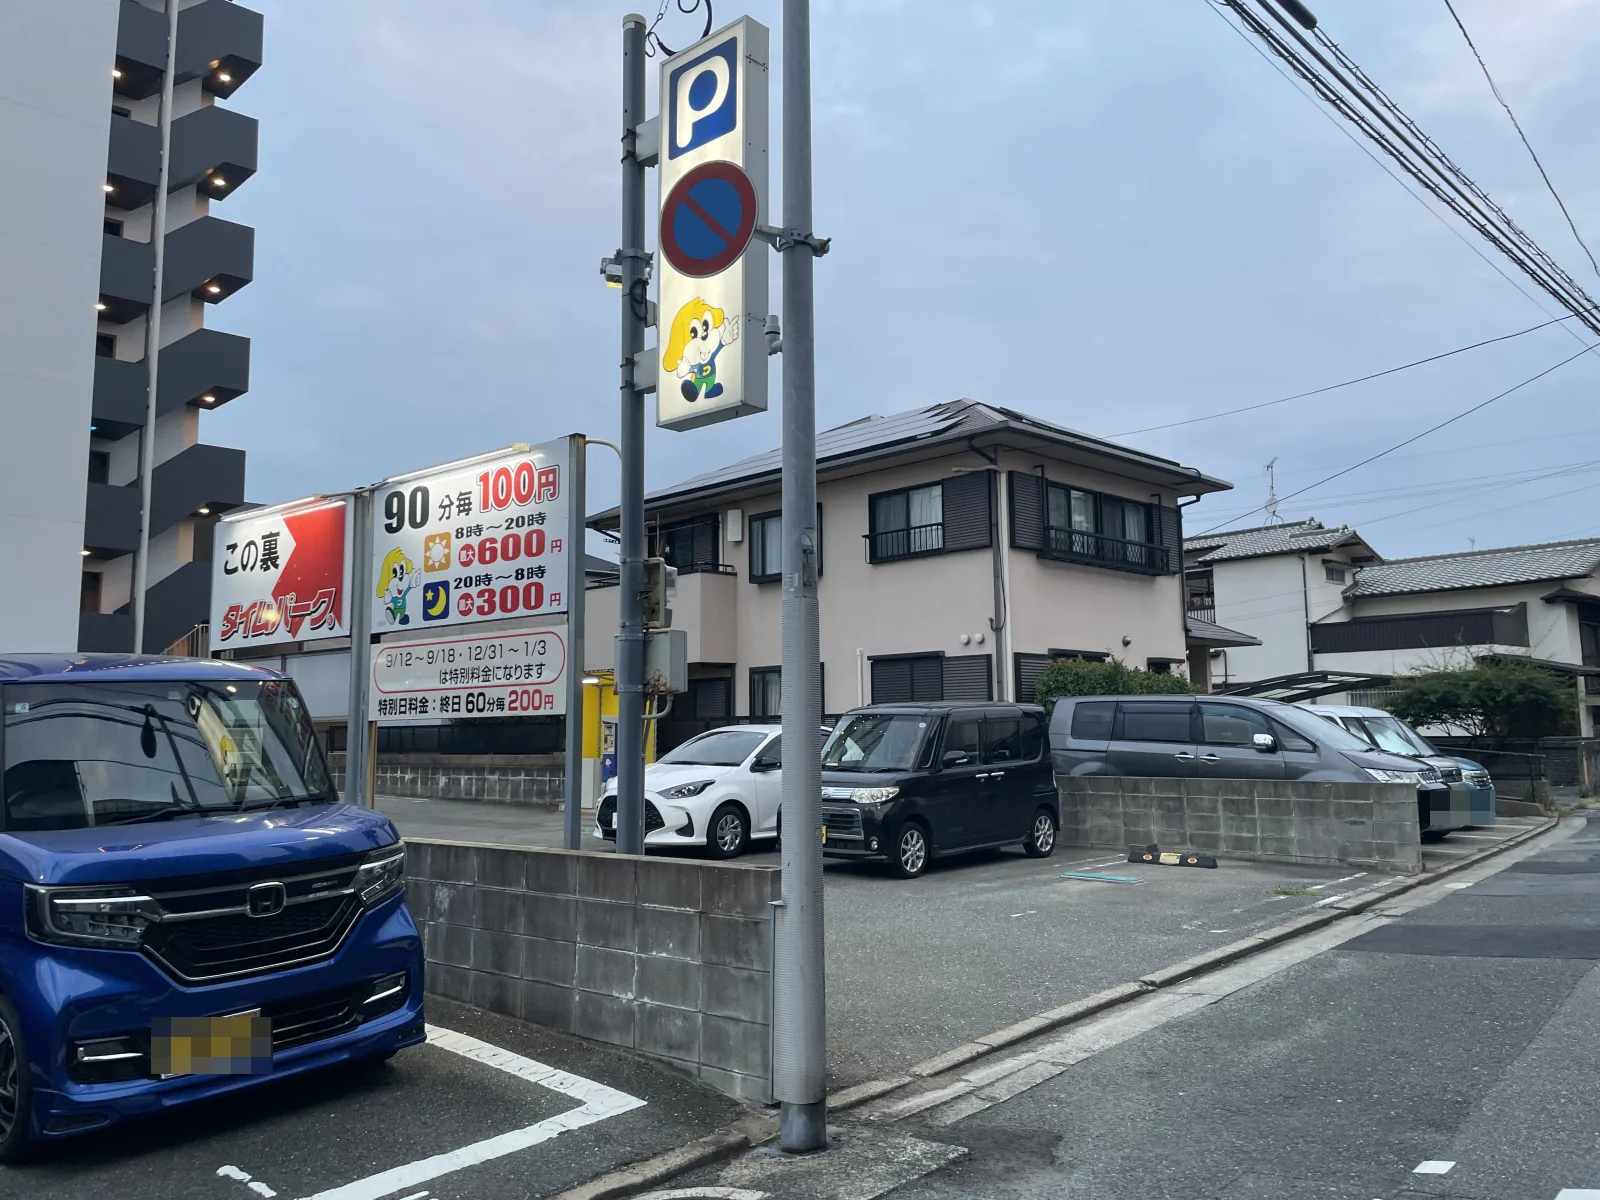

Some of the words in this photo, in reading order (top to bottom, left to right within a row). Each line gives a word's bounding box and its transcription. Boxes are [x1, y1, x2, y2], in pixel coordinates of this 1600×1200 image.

[676, 55, 730, 149] P
[384, 485, 430, 534] 90
[438, 490, 473, 522] 分毎
[477, 460, 560, 514] 100円
[224, 531, 280, 575] この裏
[439, 661, 546, 685] は特別料金になります
